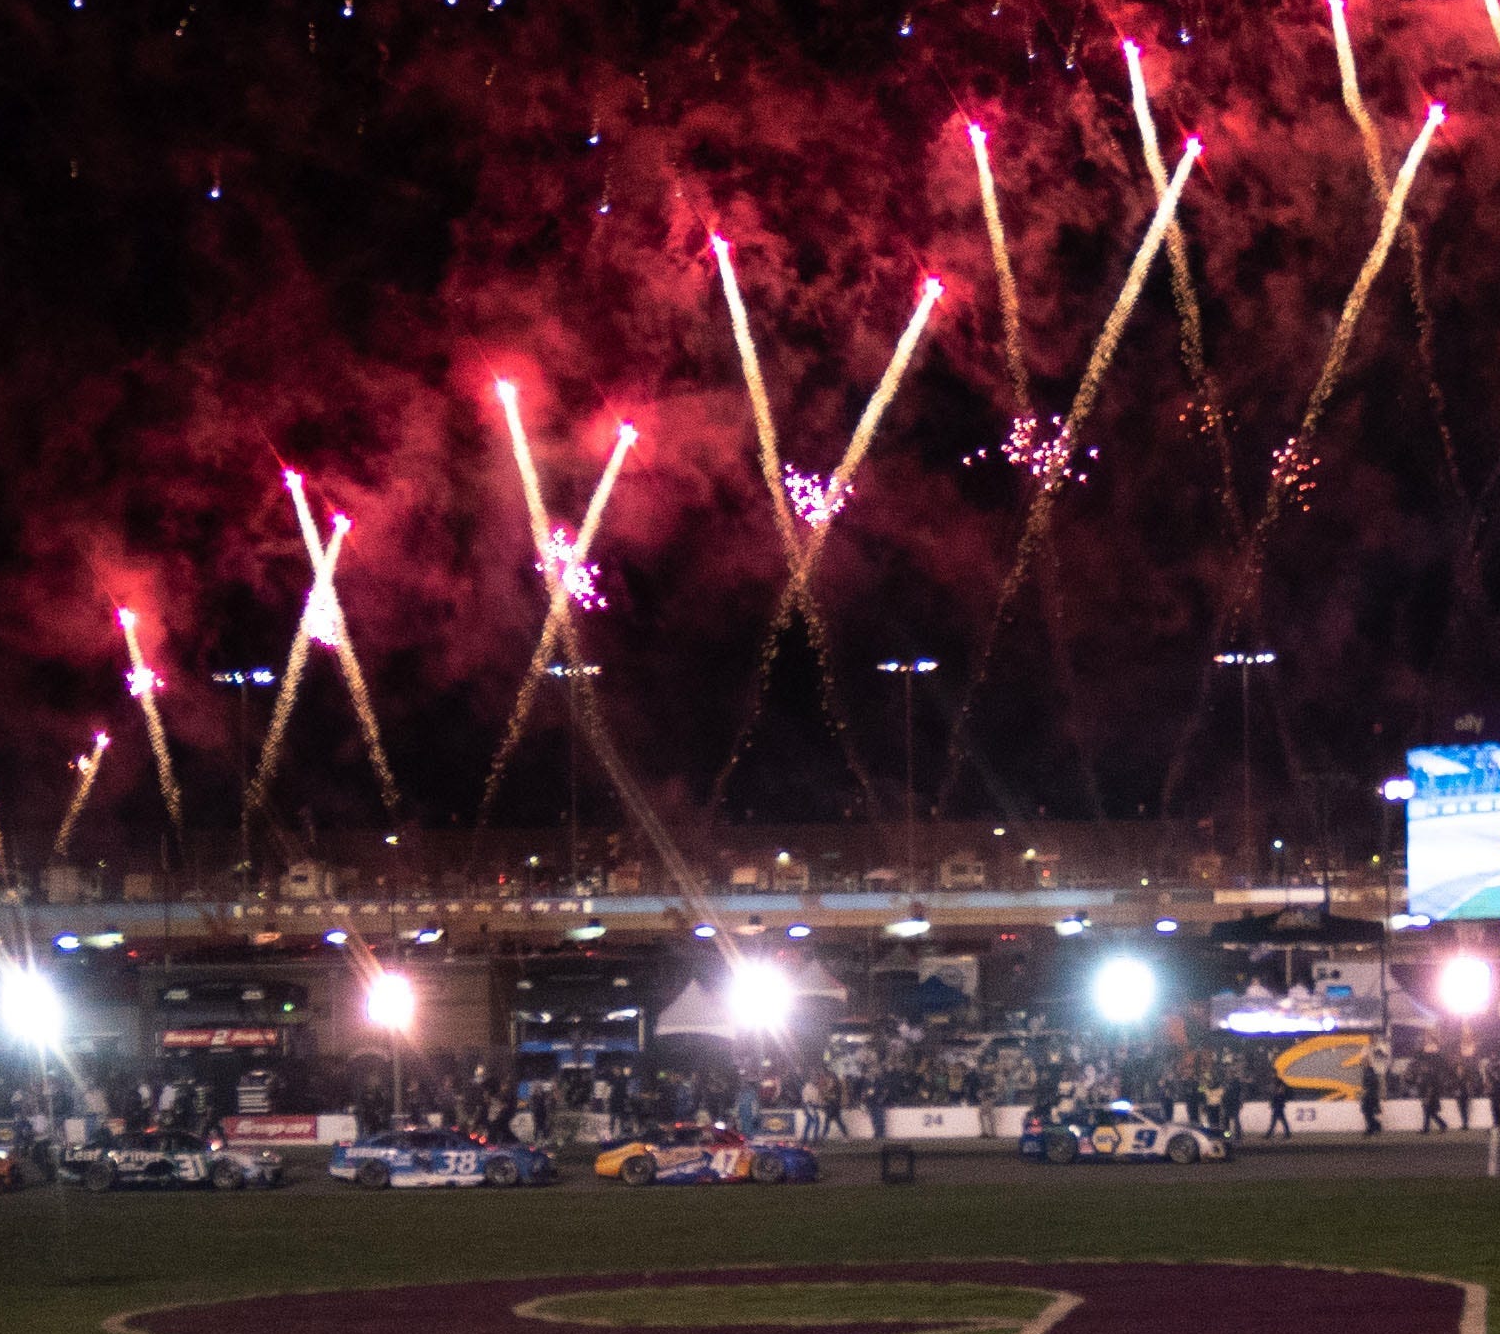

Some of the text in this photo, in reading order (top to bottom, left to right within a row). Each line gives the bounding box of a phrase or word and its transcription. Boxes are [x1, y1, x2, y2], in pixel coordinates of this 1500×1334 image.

[923, 1113, 944, 1127] 24
[1295, 1107, 1318, 1121] 23
[1131, 1129, 1158, 1149] 9
[65, 1148, 103, 1162] Leaf
[174, 1153, 207, 1182] 31
[443, 1150, 478, 1174] 38
[711, 1148, 740, 1174] 47
